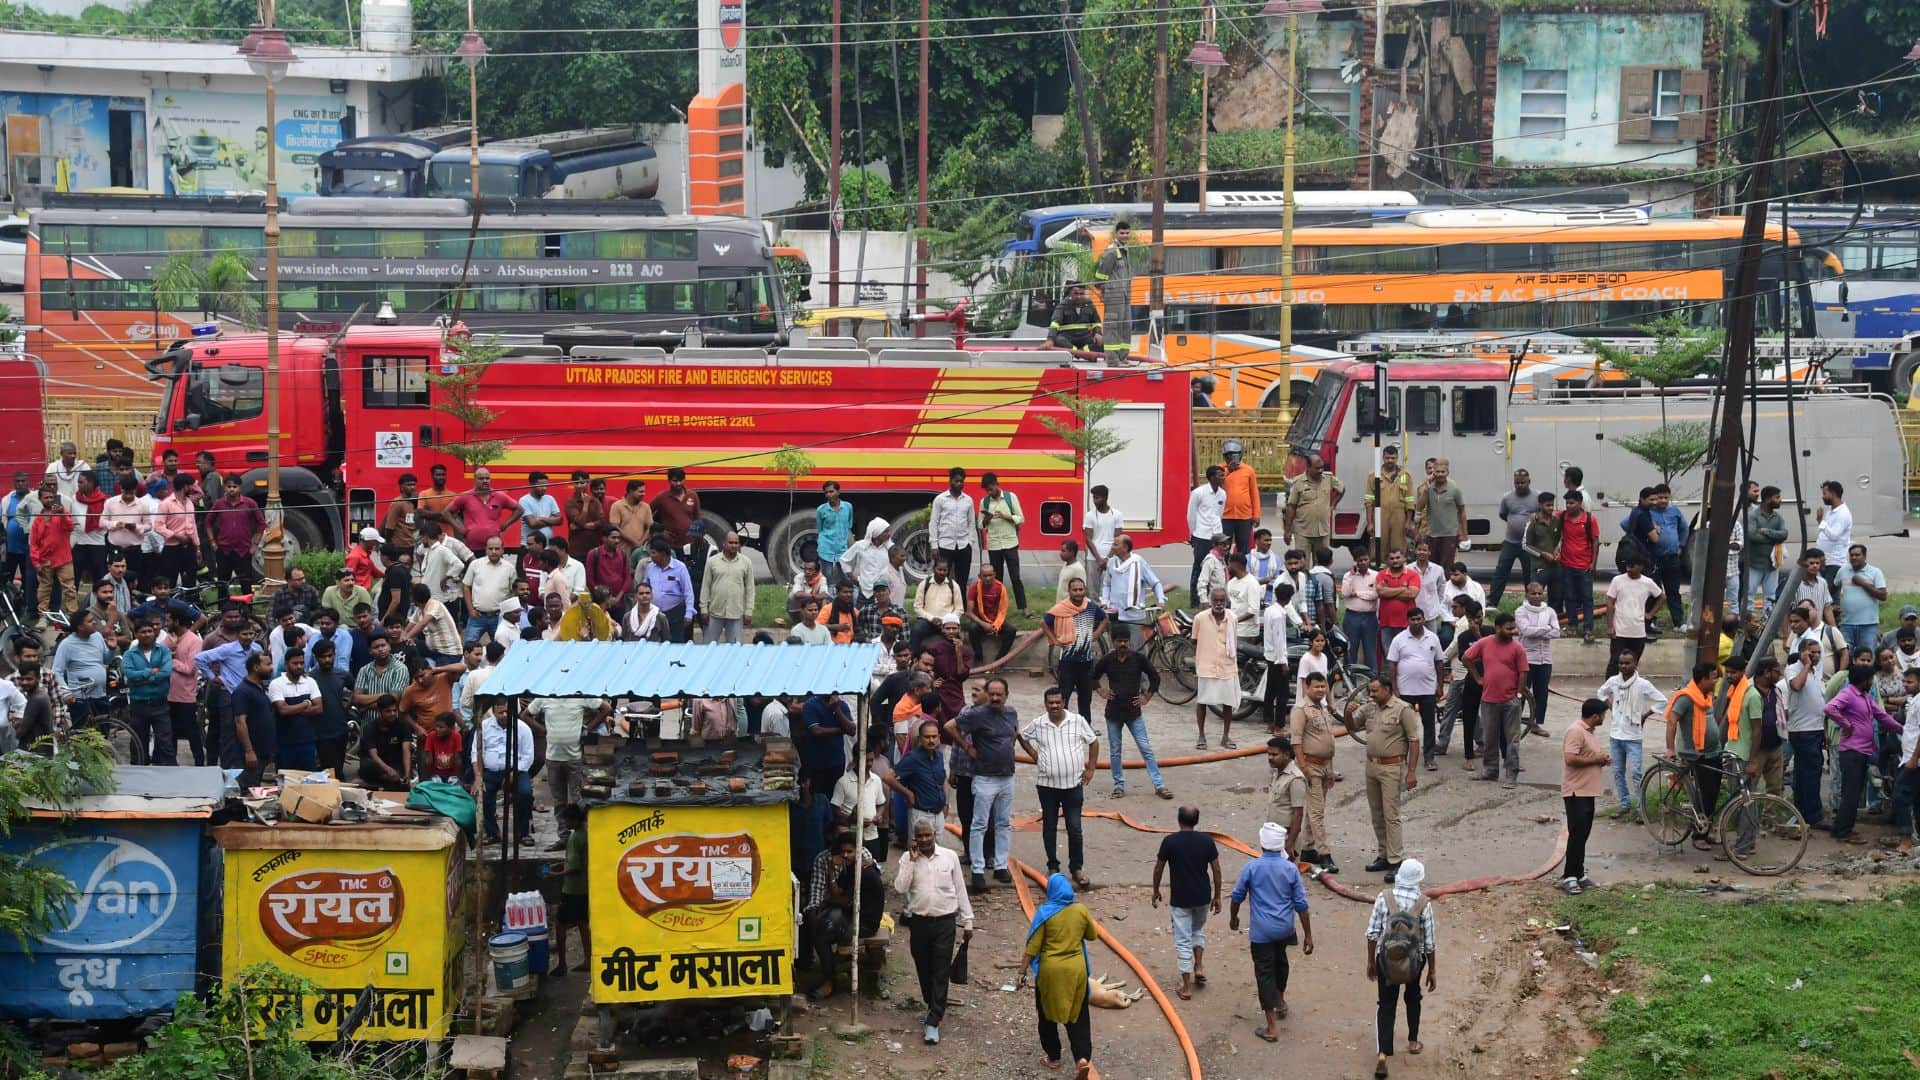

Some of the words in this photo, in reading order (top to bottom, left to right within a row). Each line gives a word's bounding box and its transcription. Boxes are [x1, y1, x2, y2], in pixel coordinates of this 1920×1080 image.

[386, 264, 414, 275] Lower
[416, 264, 449, 278] Sleeper
[640, 264, 664, 277] A/C
[1515, 275, 1536, 284] AIR
[1540, 273, 1627, 284] SUSPENSION
[1498, 289, 1525, 302] AC
[1533, 288, 1614, 302] SLEEPER
[1621, 287, 1688, 300] COACH
[566, 367, 602, 384] UTTAR
[605, 368, 654, 385] PRADESH
[658, 369, 683, 385] FIRE
[685, 369, 708, 385] AND
[711, 370, 776, 386] EMERGENCY
[779, 370, 832, 386] SERVICES
[644, 415, 680, 426] WATER
[683, 415, 727, 427] BOWSER
[729, 416, 756, 427] 22KL
[700, 844, 729, 857] TMC
[626, 844, 752, 904] रॉय
[339, 878, 367, 890] TMC
[268, 880, 394, 940] रॉयल
[662, 913, 705, 928] Spices
[303, 949, 349, 965] Spices
[601, 947, 661, 992] मीट
[670, 949, 785, 989] मसाला
[56, 958, 121, 1006] दूध
